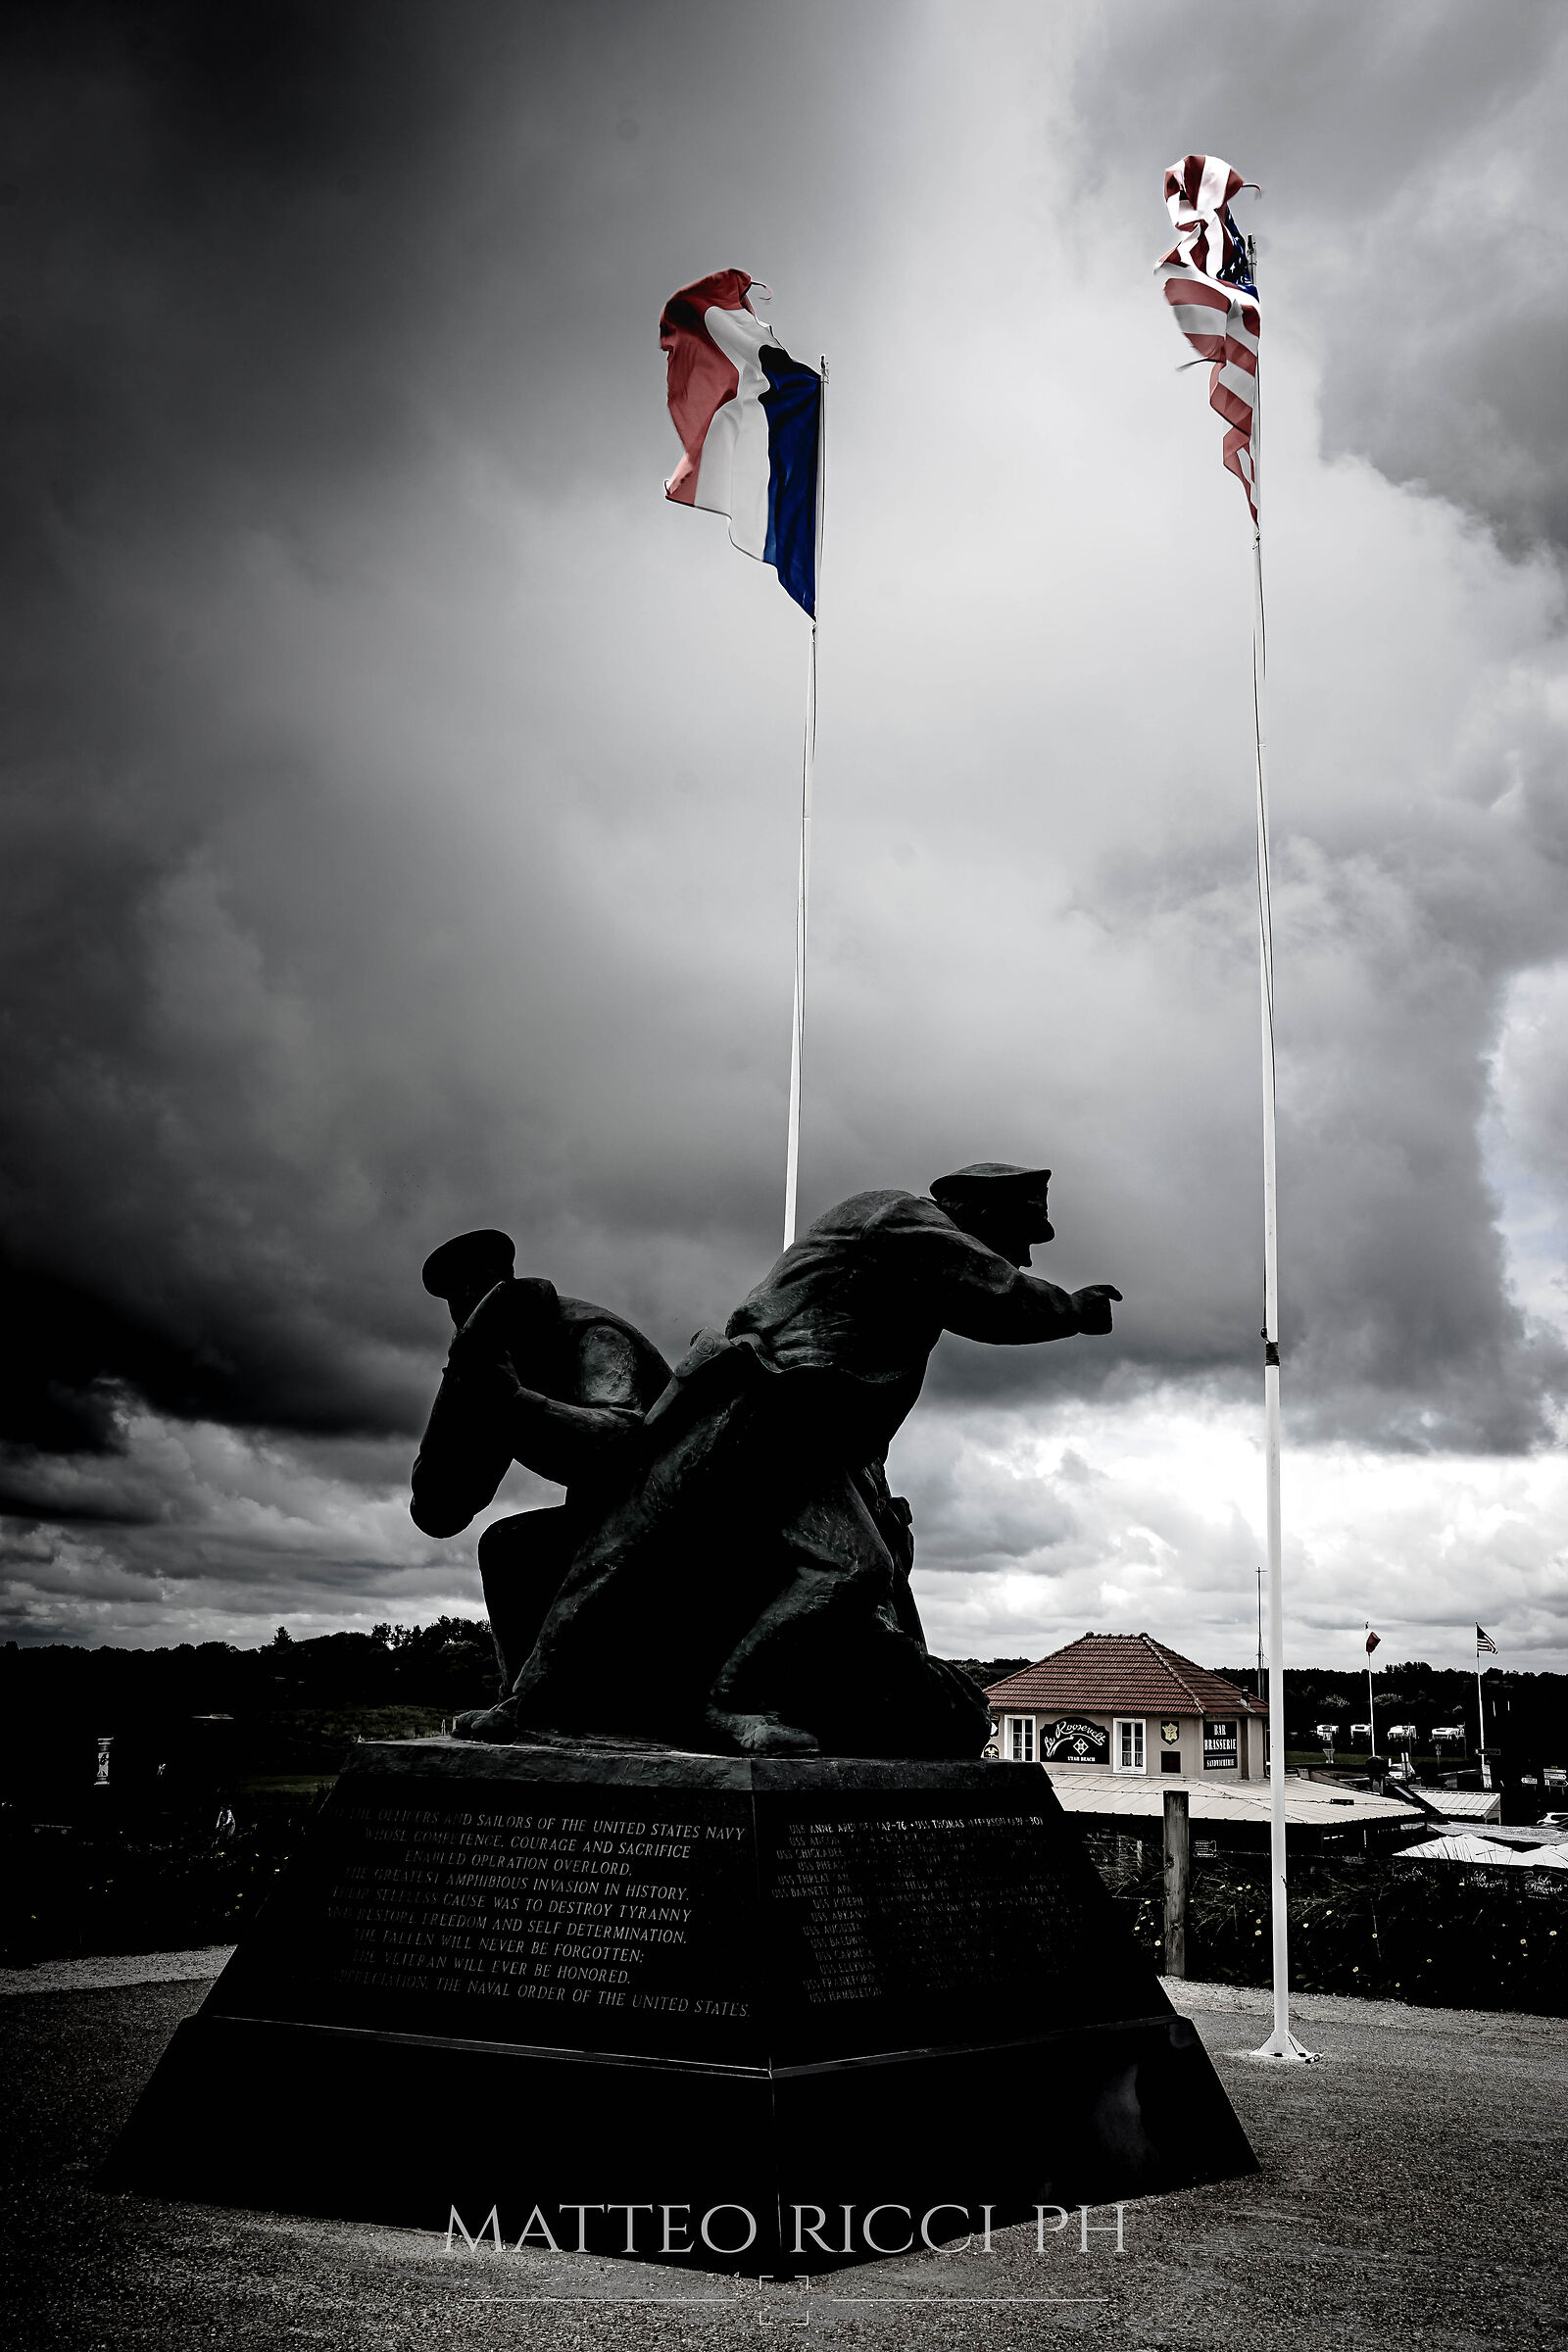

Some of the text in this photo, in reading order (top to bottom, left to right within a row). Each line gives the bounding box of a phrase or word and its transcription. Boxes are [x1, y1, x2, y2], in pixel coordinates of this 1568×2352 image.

[1055, 1721, 1105, 1743] Roosevelt
[1214, 1724, 1226, 1736] BAR
[1203, 1739, 1237, 1750] BRASSERIE
[443, 1813, 472, 1826] AND
[477, 1813, 533, 1829] SAILORS
[538, 1817, 557, 1831] OF
[562, 1818, 588, 1833] THE
[593, 1820, 646, 1836] UNITED
[651, 1823, 702, 1839] STATES
[706, 1826, 746, 1841] NAVY
[404, 1849, 467, 1865] ENABLED
[471, 1853, 549, 1870] OPERATION
[511, 1836, 578, 1852] COURAGE
[582, 1840, 613, 1854] AND
[617, 1841, 692, 1859] SACRIFICE
[373, 1867, 440, 1884] GREATEST
[445, 1873, 529, 1889] AMPHIBIOUS
[533, 1879, 600, 1895] INVASION
[604, 1883, 620, 1896] IN
[443, 1892, 487, 1908] CAUSE
[494, 1896, 520, 1911] WAS
[525, 1898, 544, 1912] TO
[548, 1899, 614, 1917] DESTROY
[619, 1904, 693, 1923] TYRANNY
[421, 1912, 488, 1930] FREEDOM
[492, 1918, 523, 1933] AND
[527, 1920, 563, 1935] SELF
[354, 1929, 376, 1941] THE
[382, 1930, 435, 1945] FALLEN
[441, 1935, 472, 1950] WILL
[478, 1937, 525, 1954] NEVER
[530, 1940, 549, 1955] BE
[384, 1952, 448, 1969] VETERAN
[454, 1956, 486, 1973] WILL
[491, 1959, 528, 1976] EVER
[533, 1963, 553, 1978] BE
[435, 1976, 463, 1991] THE
[466, 1980, 511, 1996] NAVAL
[517, 1984, 565, 2000] ORDER
[572, 1988, 592, 2003] OF
[599, 1990, 625, 2006] THE
[632, 1992, 689, 2012] UNITED
